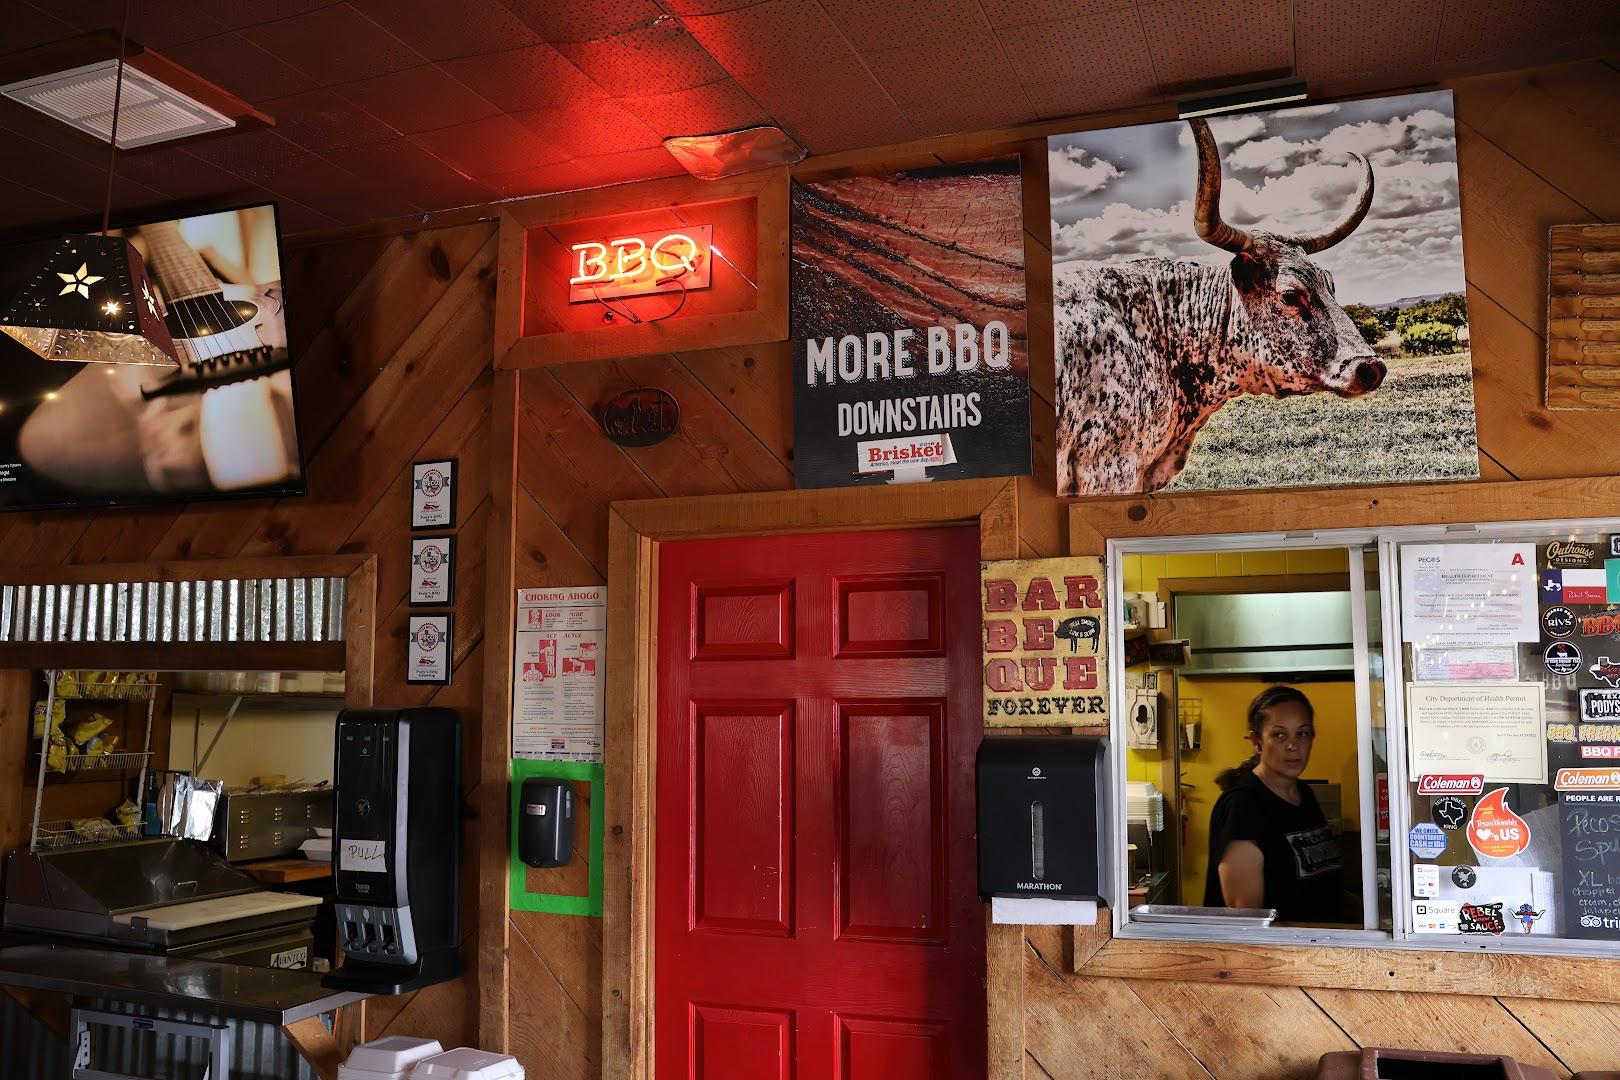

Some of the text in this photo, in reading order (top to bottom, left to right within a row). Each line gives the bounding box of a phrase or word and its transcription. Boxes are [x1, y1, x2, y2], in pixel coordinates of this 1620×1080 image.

[570, 234, 697, 284] BBQ
[807, 320, 1010, 387] MORE BBQ
[838, 392, 982, 436] DOWNSTAIRS
[868, 441, 943, 462] Brisket
[1547, 541, 1594, 559] Outhouse
[1511, 553, 1524, 565] A
[525, 592, 599, 601] CHOKING AHOGO
[985, 576, 1102, 612] BAR
[985, 617, 1055, 653] BE
[985, 656, 1098, 692] QUE
[987, 696, 1105, 715] FOREVER
[1425, 695, 1438, 703] City
[1440, 695, 1474, 703] Department
[1583, 747, 1611, 757] BBQ
[1424, 776, 1470, 789] Coleman
[1561, 772, 1609, 784] Coleman
[1434, 796, 1449, 806] TEXAS
[1410, 833, 1444, 841] COUNTERFEIT
[1500, 828, 1519, 840] US
[1410, 840, 1428, 848] CASH
[349, 844, 384, 860] PULL
[1579, 870, 1603, 886] XL
[1017, 882, 1062, 891] MARATHON
[1428, 906, 1456, 914] Square
[1462, 906, 1497, 920] REBEL
[1470, 920, 1502, 931] SAUCE
[271, 952, 306, 967] AVANTCO
